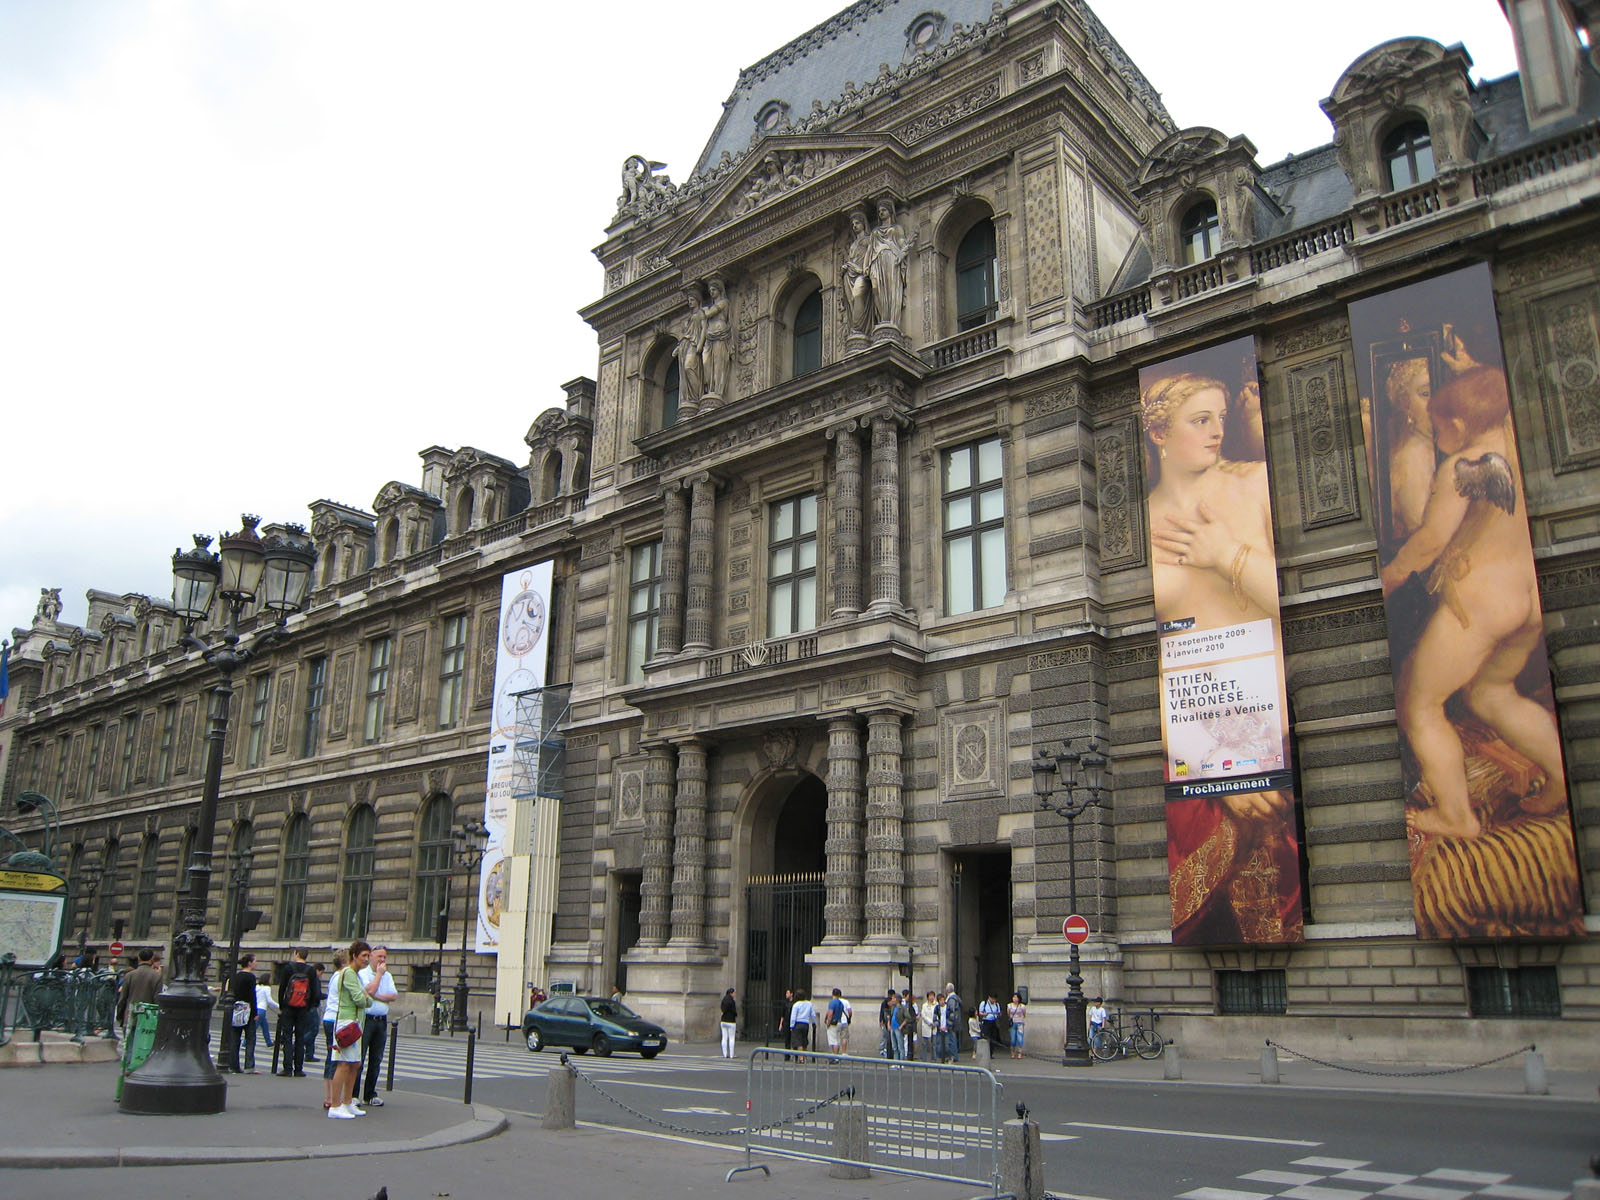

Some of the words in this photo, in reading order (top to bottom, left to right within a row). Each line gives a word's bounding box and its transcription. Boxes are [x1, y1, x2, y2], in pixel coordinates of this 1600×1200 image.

[1178, 634, 1223, 647] septembre
[1225, 629, 1246, 639] 2009
[1174, 648, 1203, 659] janvier
[1206, 642, 1225, 652] 2010
[1168, 672, 1217, 687] TITIEN,
[1169, 680, 1240, 699] TINTORET,
[1171, 710, 1221, 724] Rivalités
[1225, 707, 1231, 717] à
[1234, 703, 1274, 715] Venise
[1183, 778, 1271, 795] Prochainement
